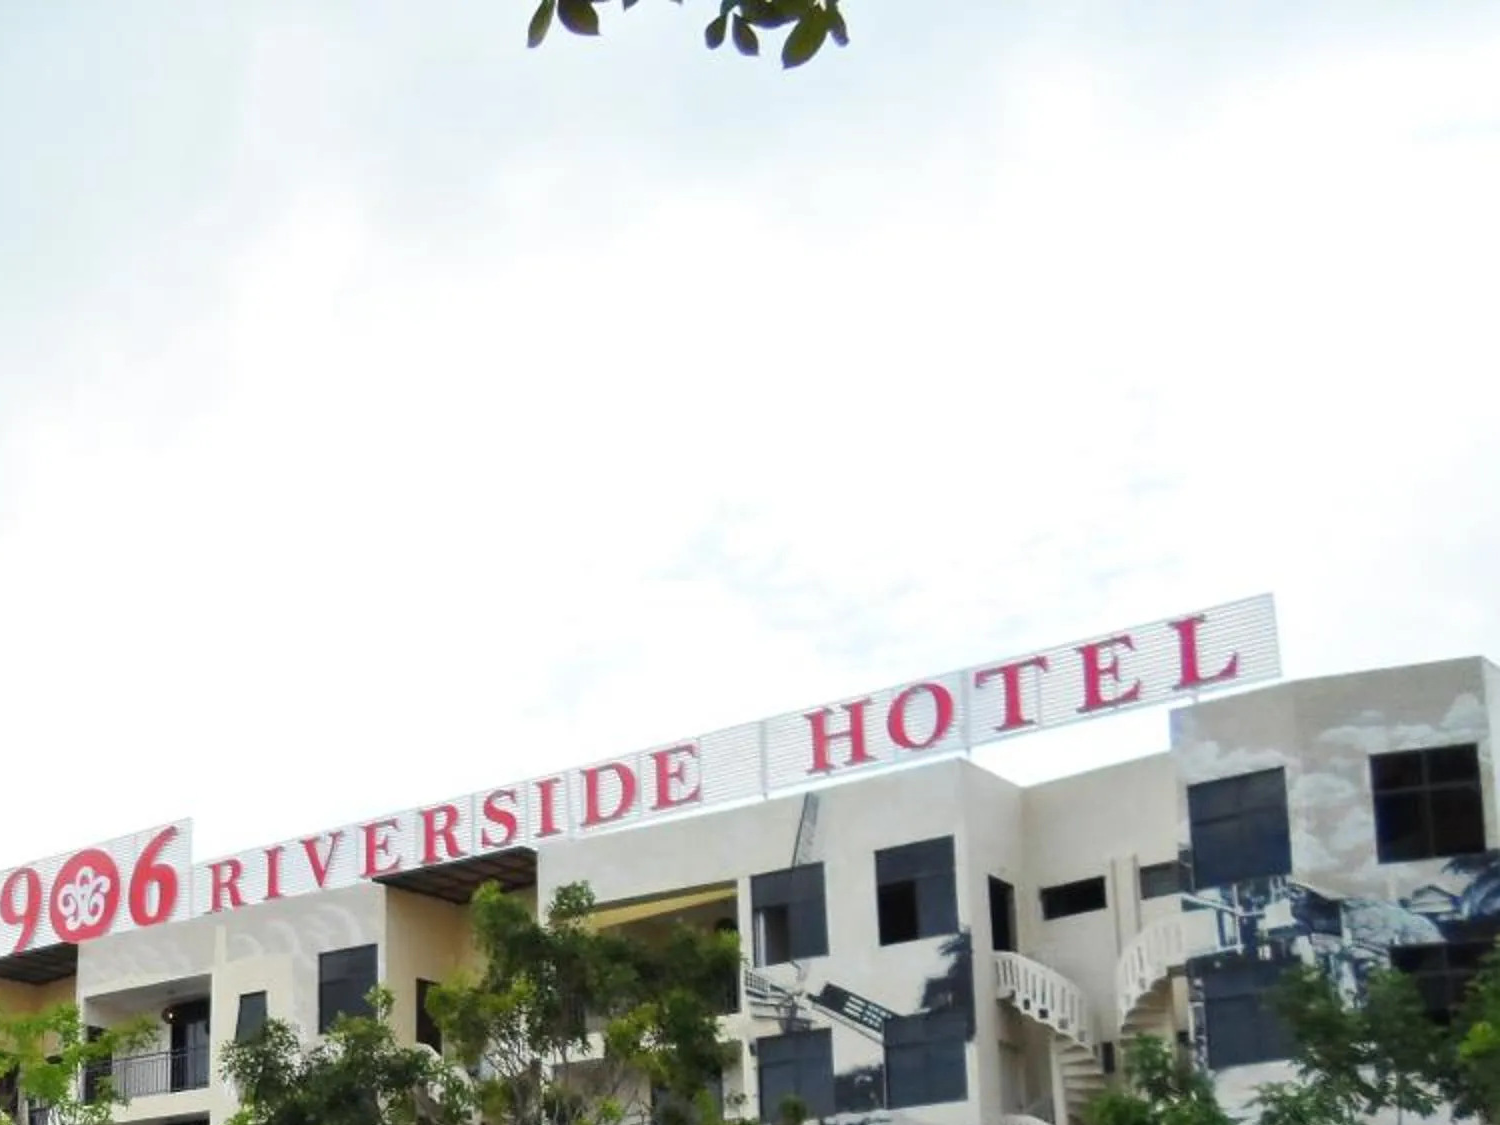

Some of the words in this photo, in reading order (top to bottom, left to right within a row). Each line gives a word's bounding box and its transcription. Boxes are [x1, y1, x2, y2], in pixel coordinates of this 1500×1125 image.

[0, 825, 179, 955] 906
[208, 743, 702, 914] RIVERSIDE
[803, 614, 1239, 774] HOTEL
